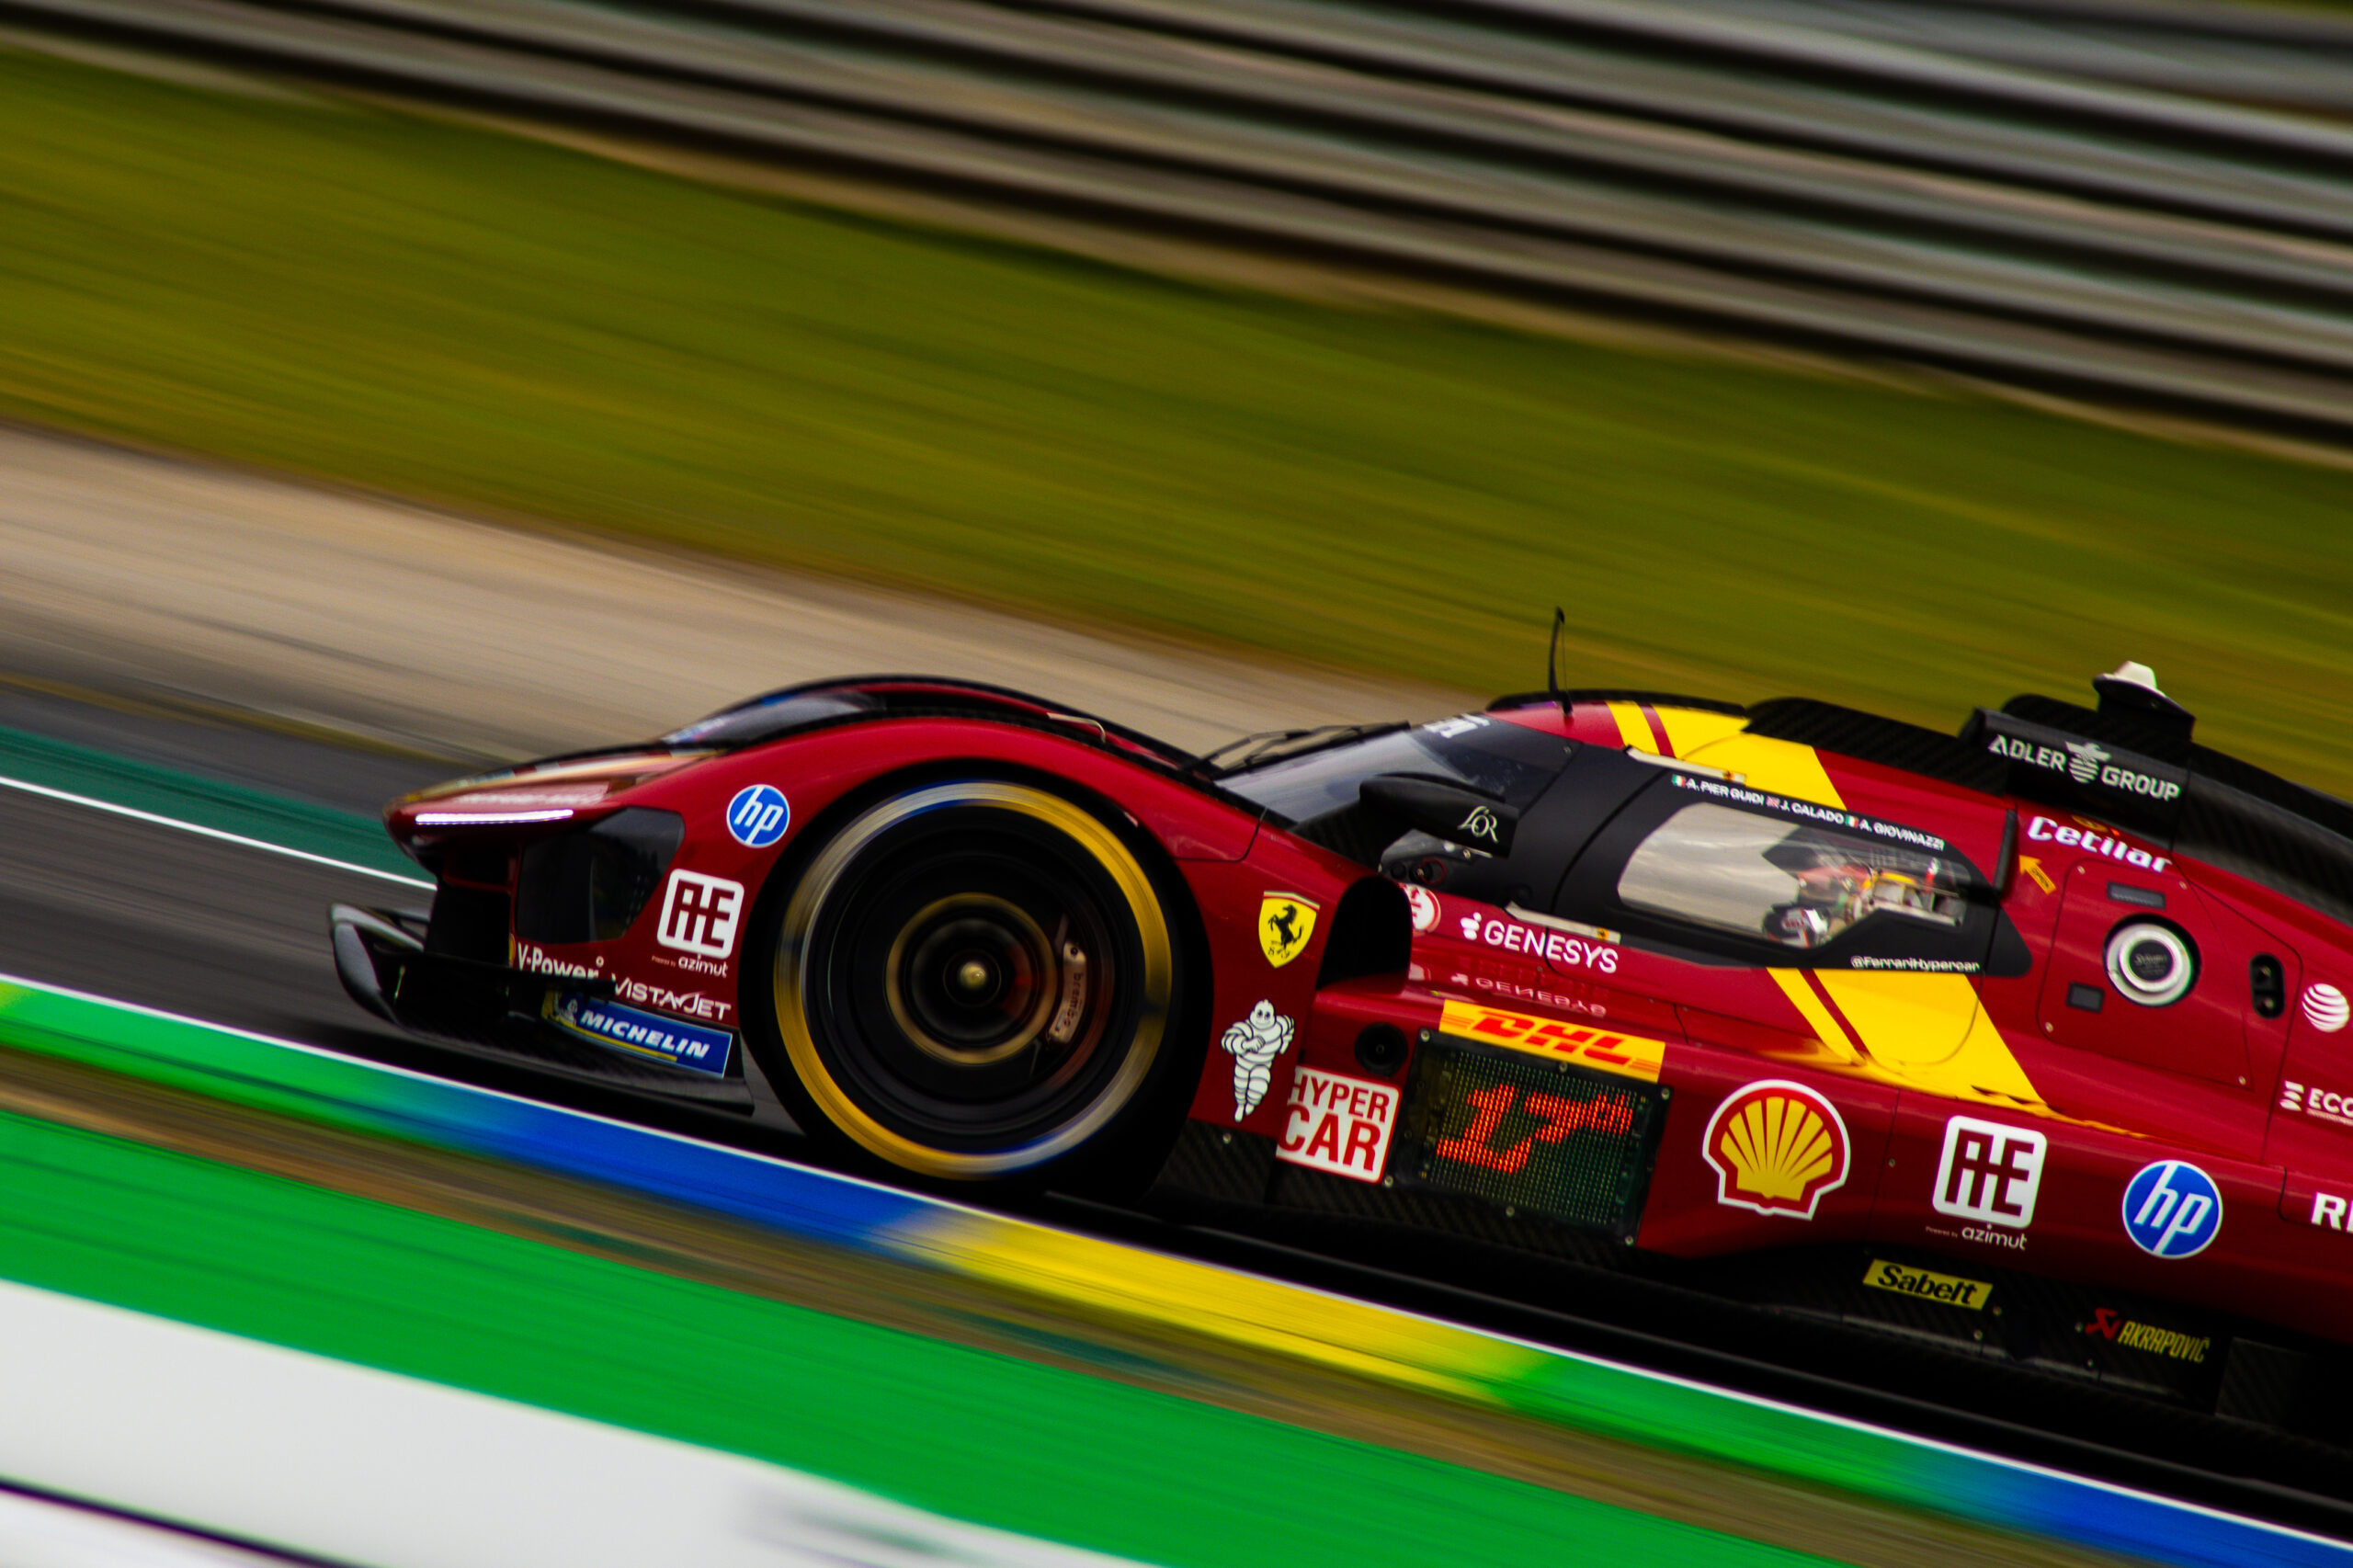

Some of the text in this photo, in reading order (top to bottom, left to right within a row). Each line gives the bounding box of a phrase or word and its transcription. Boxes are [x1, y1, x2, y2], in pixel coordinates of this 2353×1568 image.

[1987, 734, 2181, 801] ADLER GROUP
[734, 785, 784, 846] hp
[1700, 780, 1730, 798] PIER
[1729, 788, 1765, 805] GUIDI
[1791, 802, 1845, 825] CALADO
[1872, 822, 1945, 852] GIOVINAZZI
[2027, 816, 2173, 872] Cetilar
[677, 955, 729, 978] azimut
[1484, 920, 1619, 973] GENESYS
[580, 1009, 710, 1059] MICHELIN
[1470, 1010, 1631, 1065] DHL
[1288, 1074, 1390, 1123] HYPER
[1278, 1103, 1381, 1172] CAR
[1961, 1222, 2028, 1251] azimut
[2133, 1164, 2213, 1256] hp
[1877, 1264, 1977, 1305] Sabelt
